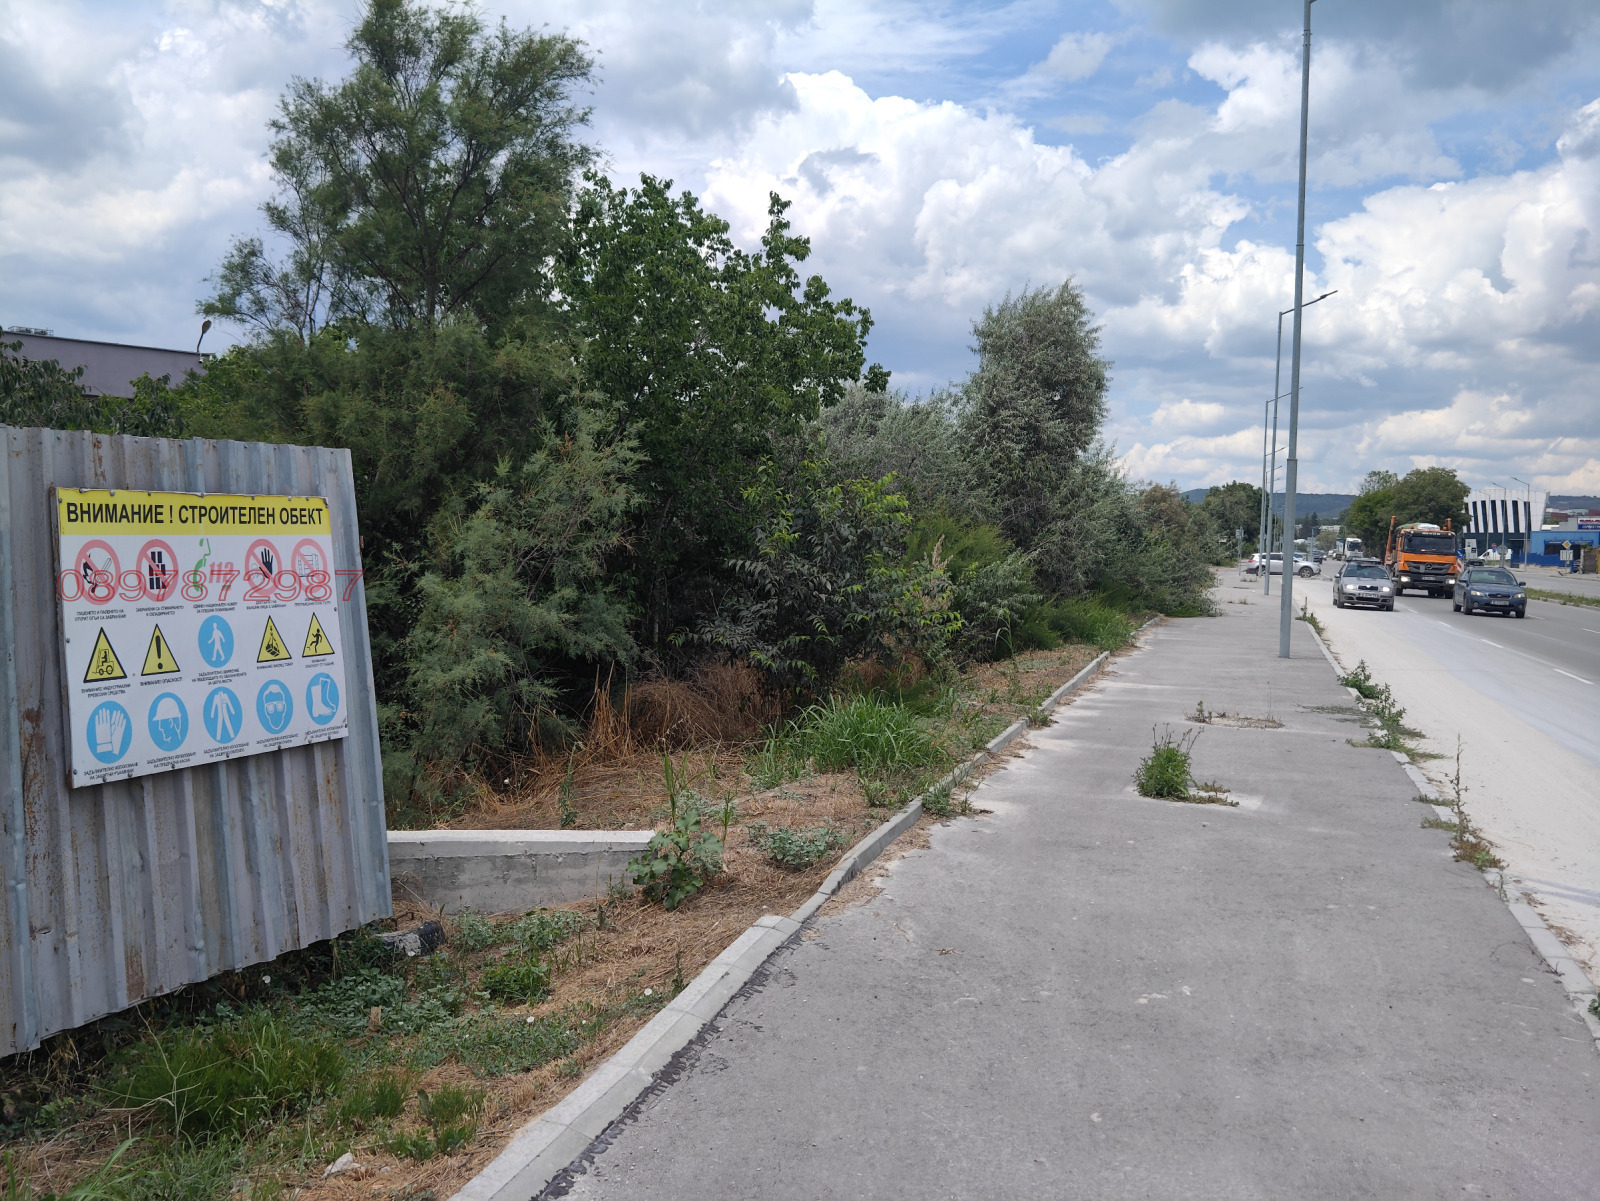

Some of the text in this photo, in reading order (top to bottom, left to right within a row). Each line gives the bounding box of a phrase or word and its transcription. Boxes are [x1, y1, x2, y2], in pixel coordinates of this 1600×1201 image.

[67, 502, 164, 523] ВНИМАНИЕ
[179, 505, 276, 525] СТРОИТЕЛЕН
[279, 507, 323, 525] ОБЕКТ
[209, 561, 234, 584] 112
